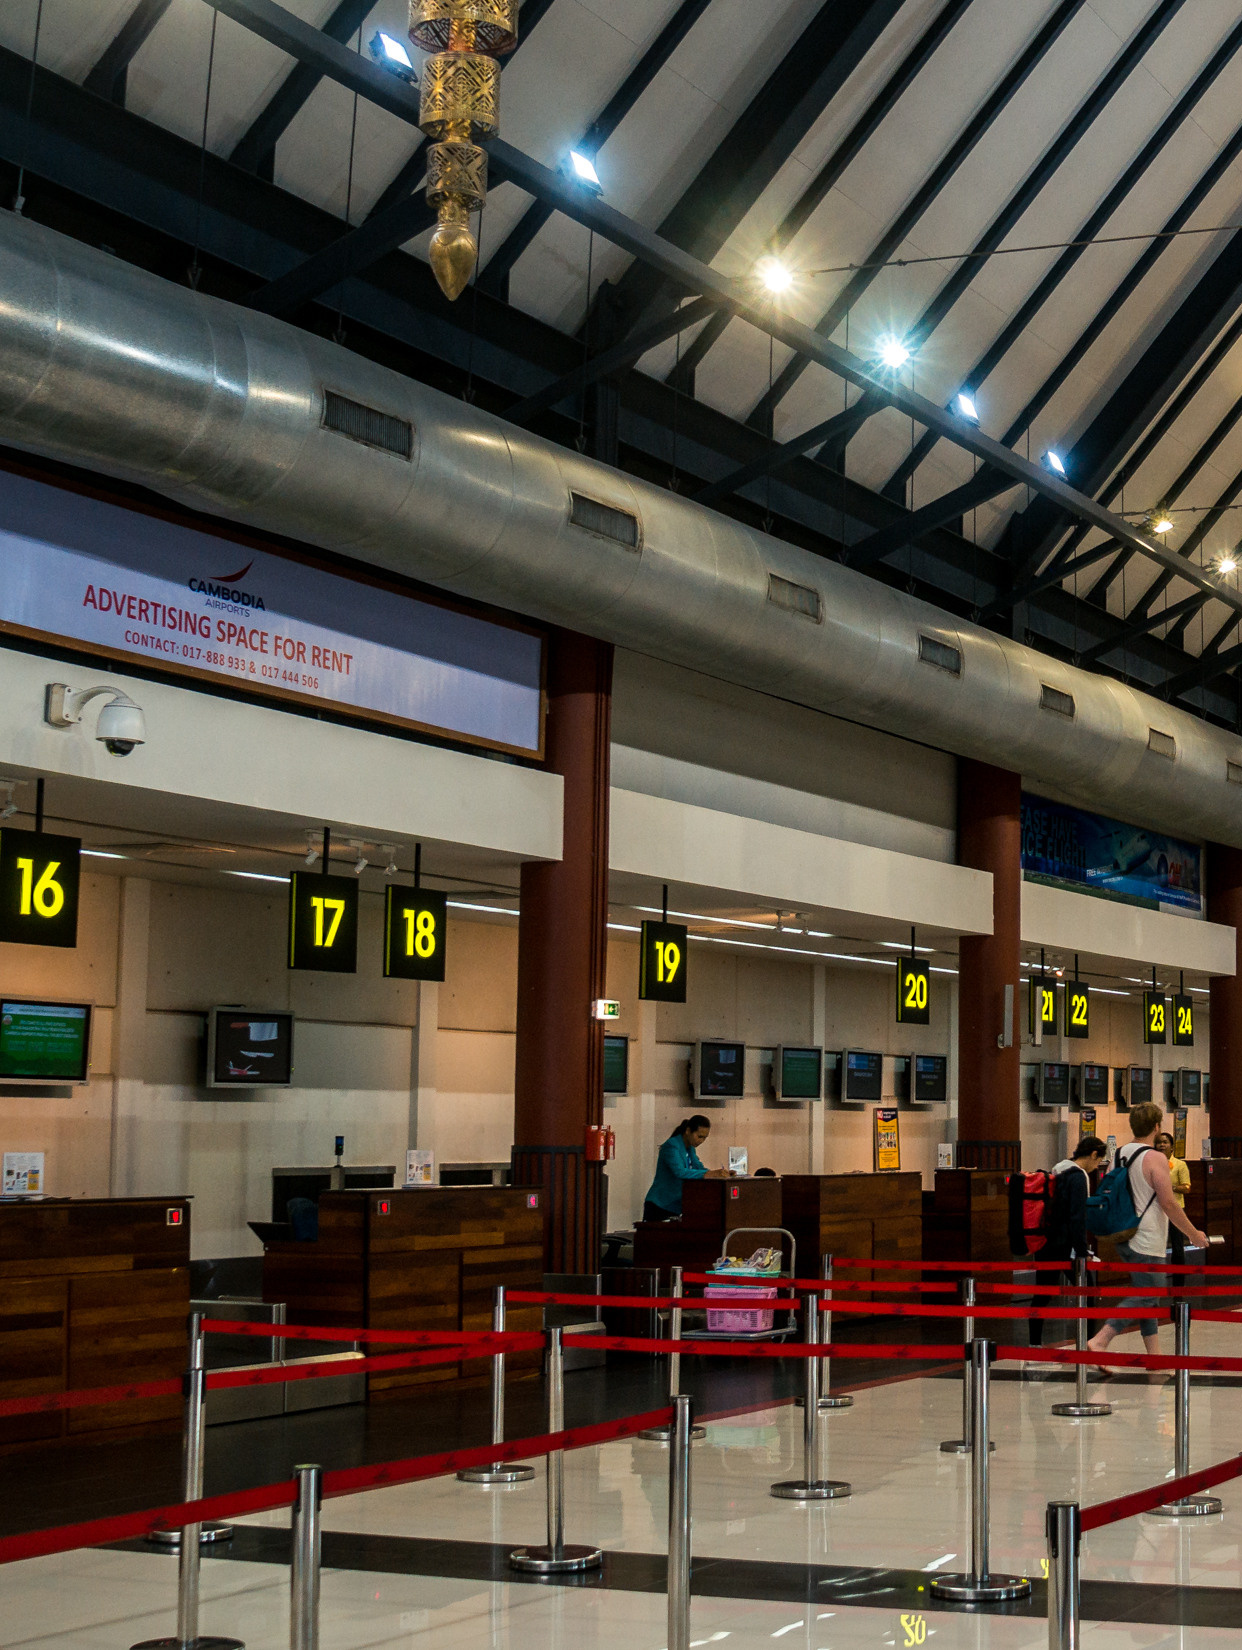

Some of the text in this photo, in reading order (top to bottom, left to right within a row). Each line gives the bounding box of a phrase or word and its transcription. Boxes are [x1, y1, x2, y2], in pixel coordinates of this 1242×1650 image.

[188, 578, 266, 611] CAMBODIA
[205, 598, 251, 618] AIRPORTS
[83, 584, 353, 675] ADVERTISING SPACE FOR RENT
[124, 630, 319, 689] CONTACT: 017-888 933 & 017 444 506
[17, 857, 64, 918] 16
[311, 897, 346, 948] 17
[403, 908, 436, 958] 18
[655, 941, 681, 983] 19
[905, 973, 928, 1010] 20
[1042, 990, 1054, 1022] 21
[1072, 994, 1088, 1026] 22
[1150, 1003, 1165, 1032] 23
[1178, 1006, 1193, 1035] 24
